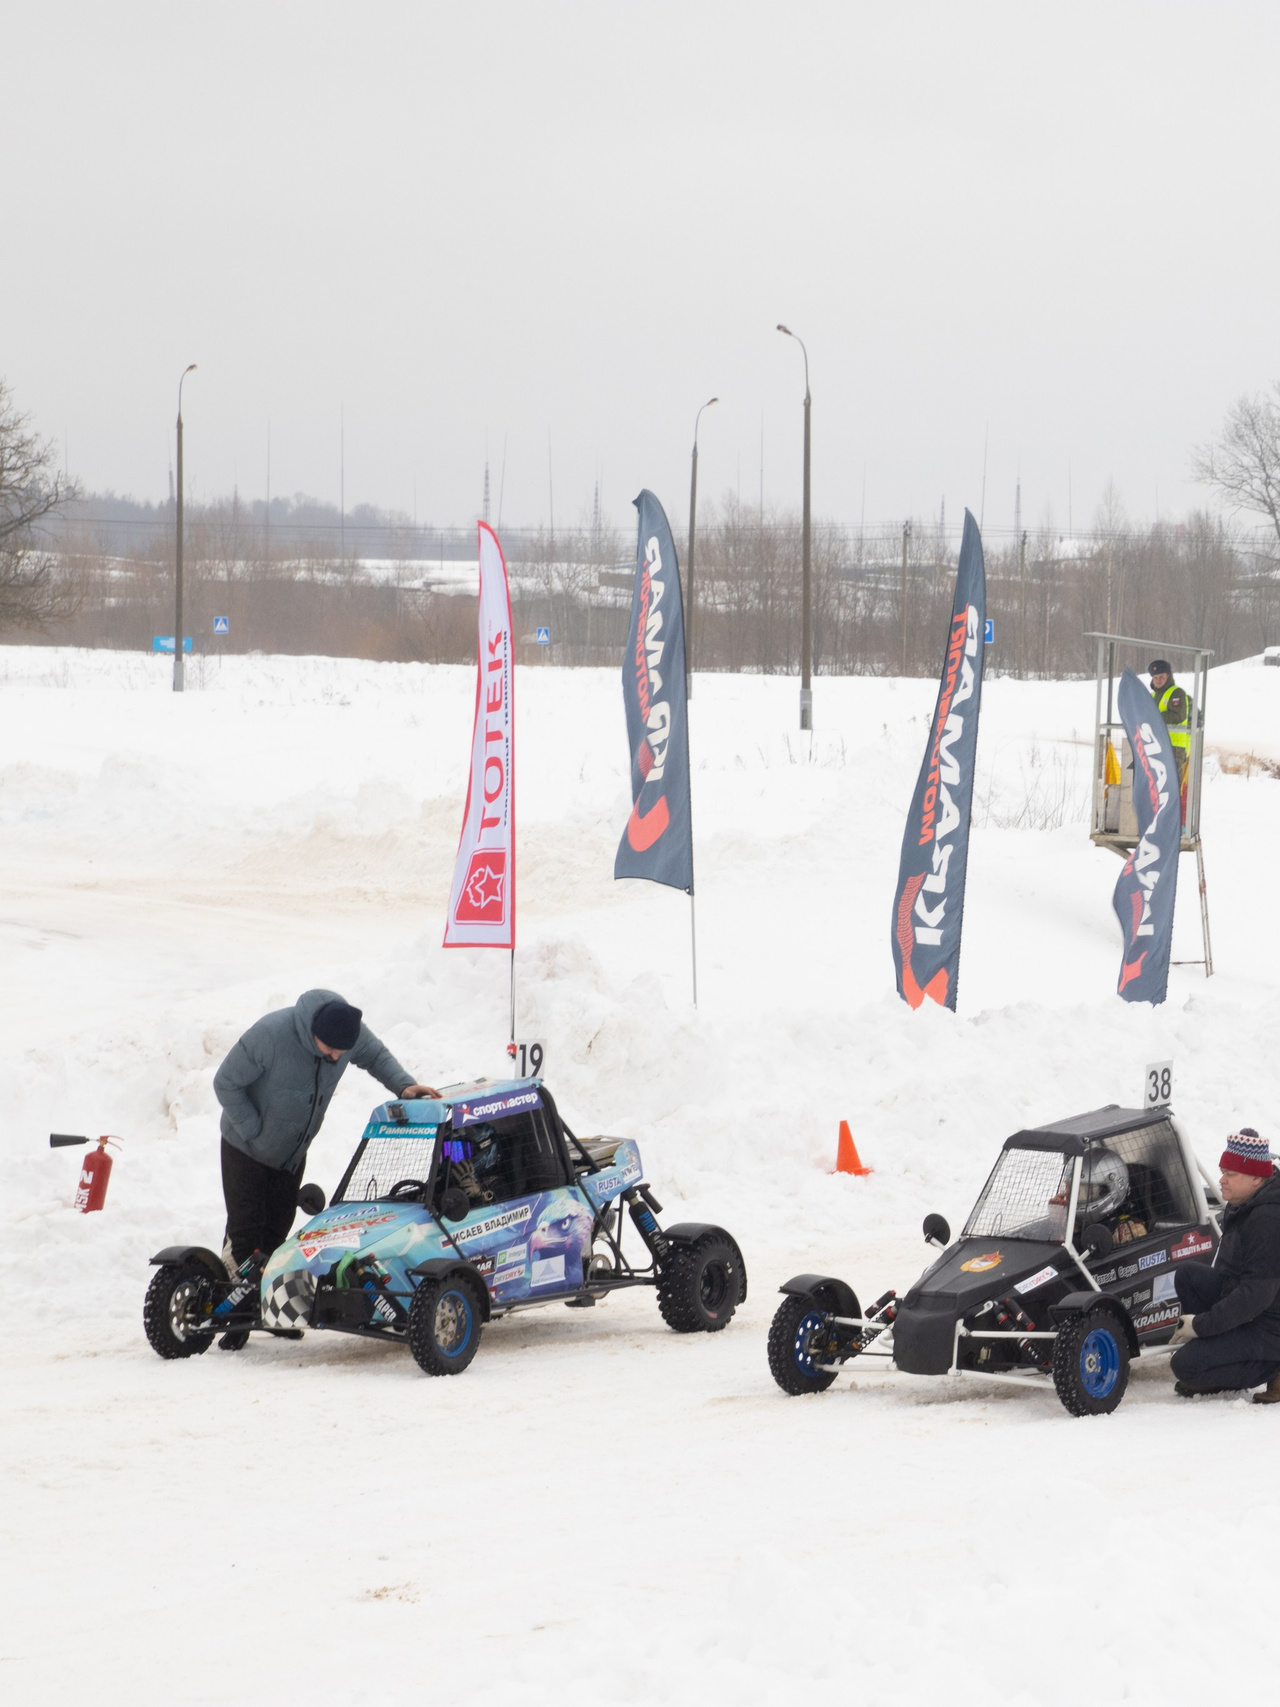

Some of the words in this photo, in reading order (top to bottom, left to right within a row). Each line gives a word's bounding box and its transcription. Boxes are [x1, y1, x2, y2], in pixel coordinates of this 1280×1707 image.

[519, 1043, 544, 1078] 19
[1148, 1067, 1171, 1102] 38
[472, 1091, 539, 1117] спортмастер
[378, 1125, 438, 1135] Раменское
[598, 1177, 622, 1193] RUSTA
[453, 1222, 483, 1242] ИСАЕВ
[485, 1207, 530, 1232] ВЛАДИМИР
[1140, 1251, 1166, 1269] RUSTA
[1133, 1306, 1179, 1328] KRAMAR
